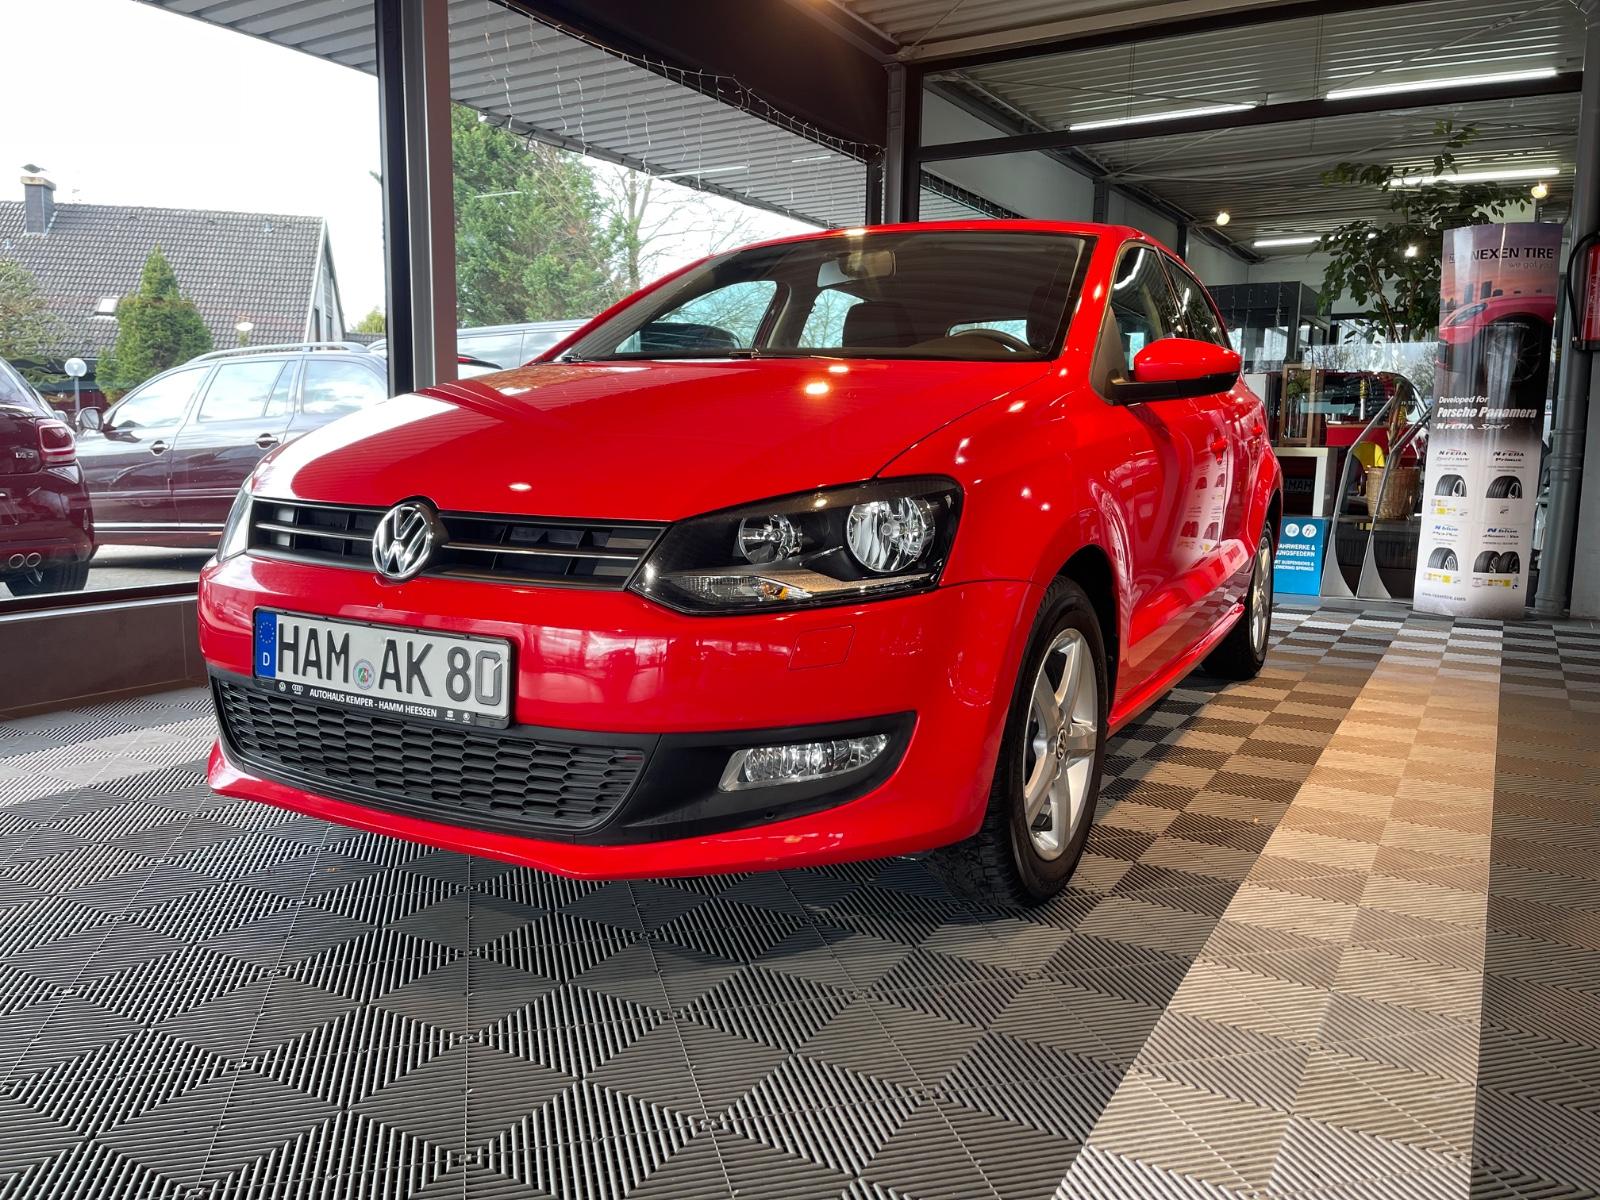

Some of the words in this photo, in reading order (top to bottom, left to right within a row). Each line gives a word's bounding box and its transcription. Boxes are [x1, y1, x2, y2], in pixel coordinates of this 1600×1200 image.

[1472, 248, 1519, 260] NEXEN
[1524, 247, 1554, 259] TIRE
[1438, 396, 1476, 405] Developed
[1476, 395, 1489, 403] for
[1436, 406, 1477, 418] Porsche
[1478, 406, 1537, 418] Panamera
[262, 651, 270, 667] D
[277, 622, 350, 684] HAM
[378, 638, 433, 698] AK
[445, 646, 502, 707] 80
[309, 688, 345, 703] AUTOHAUS
[345, 695, 374, 708] KEMPER
[378, 701, 404, 713] HAMM
[405, 705, 438, 718] HEESSEN
